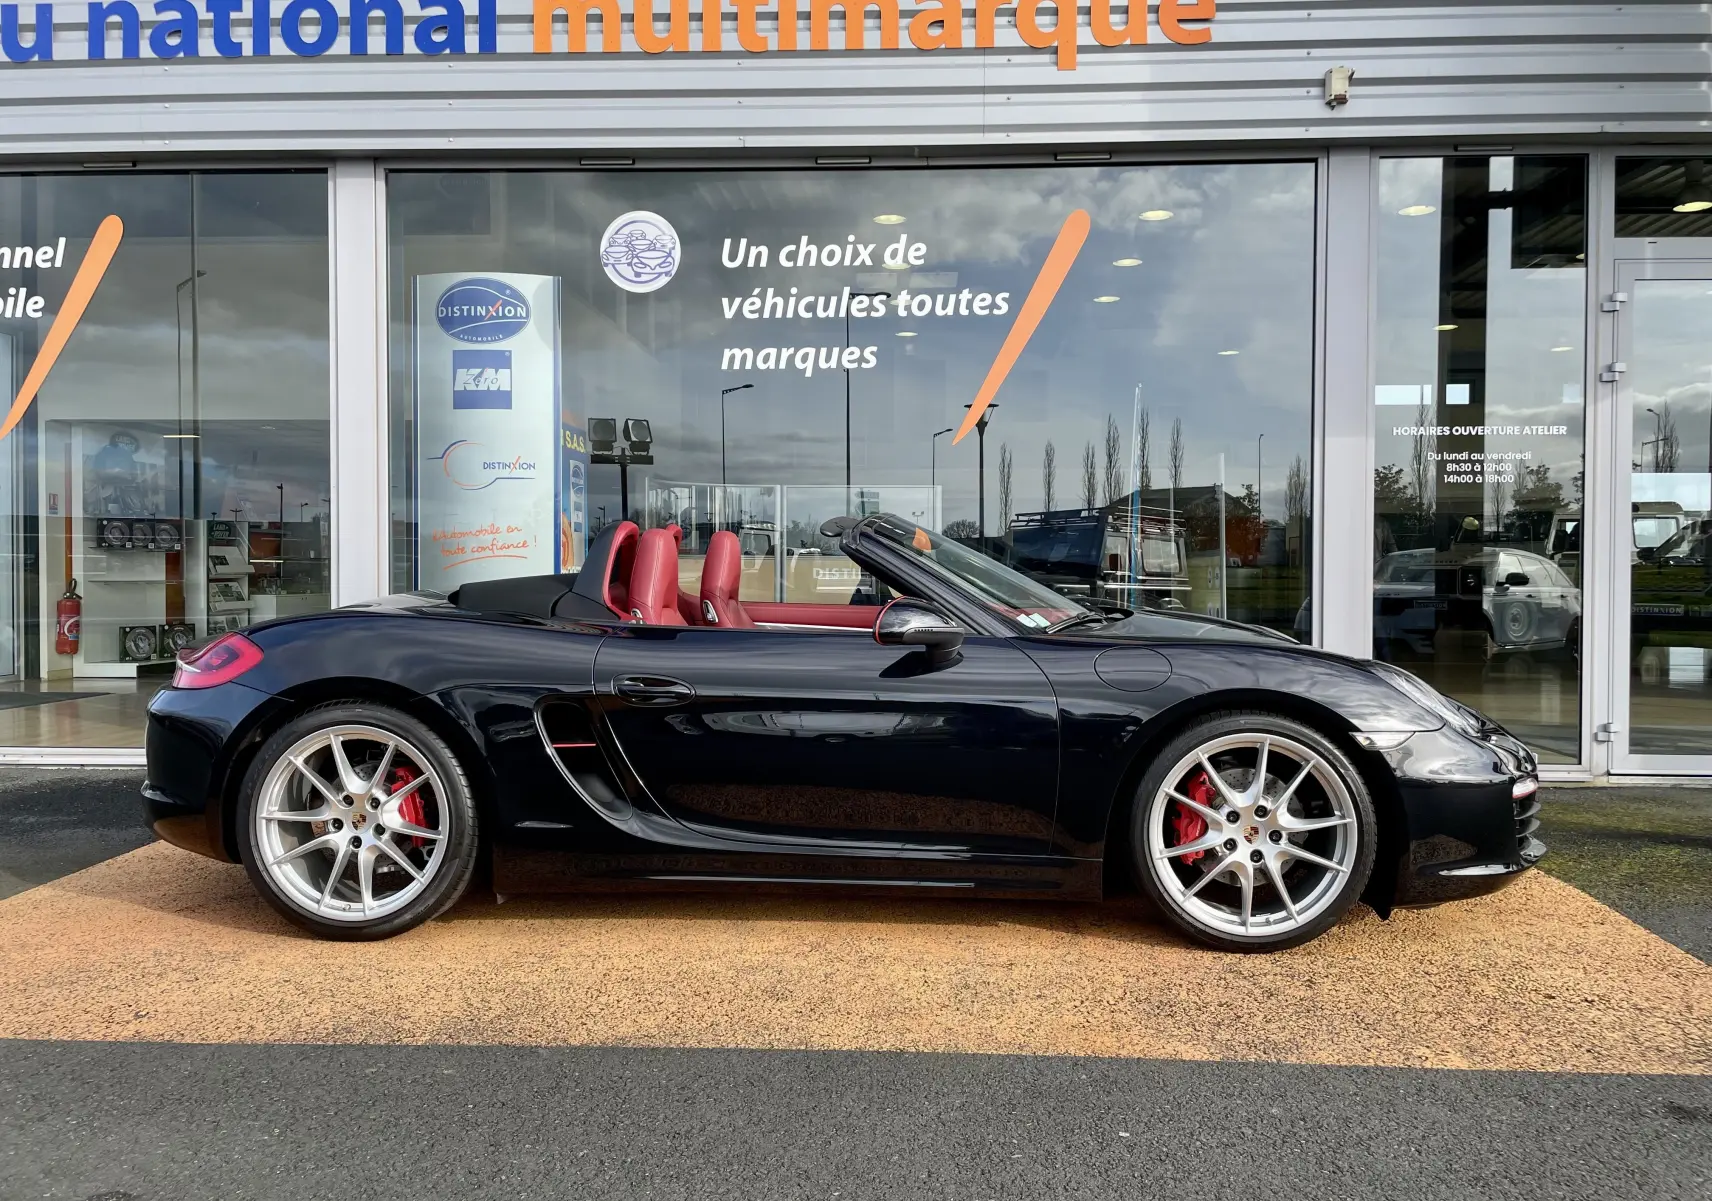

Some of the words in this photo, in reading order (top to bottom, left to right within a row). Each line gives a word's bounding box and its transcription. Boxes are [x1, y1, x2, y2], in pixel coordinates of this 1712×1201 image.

[87, 0, 498, 60] national
[532, 0, 1216, 71] multimarque
[720, 237, 769, 268] Un
[778, 234, 877, 268] choix
[883, 233, 928, 266] de
[0, 286, 46, 319] ile
[438, 302, 527, 319] DISTINXION
[721, 286, 888, 320] véhicules
[896, 288, 1010, 318] toutes
[459, 333, 504, 342] AUTOMOBILE
[720, 345, 879, 378] marques
[1392, 426, 1450, 436] HORAIRES
[1451, 425, 1521, 436] OUVERTURE
[1522, 425, 1568, 436] ATELIER
[1427, 452, 1442, 461] Du
[1443, 451, 1468, 461] lundi
[1486, 451, 1532, 461] vendredi
[483, 459, 536, 472] DISTINXION
[1446, 463, 1472, 472] 8h30
[1474, 462, 1482, 472] à
[1483, 462, 1512, 472] 12h00
[1444, 474, 1473, 484] 14h00
[1475, 473, 1483, 483] à
[1485, 474, 1515, 483] 18h00
[441, 542, 467, 557] toute
[471, 537, 530, 554] confiance
